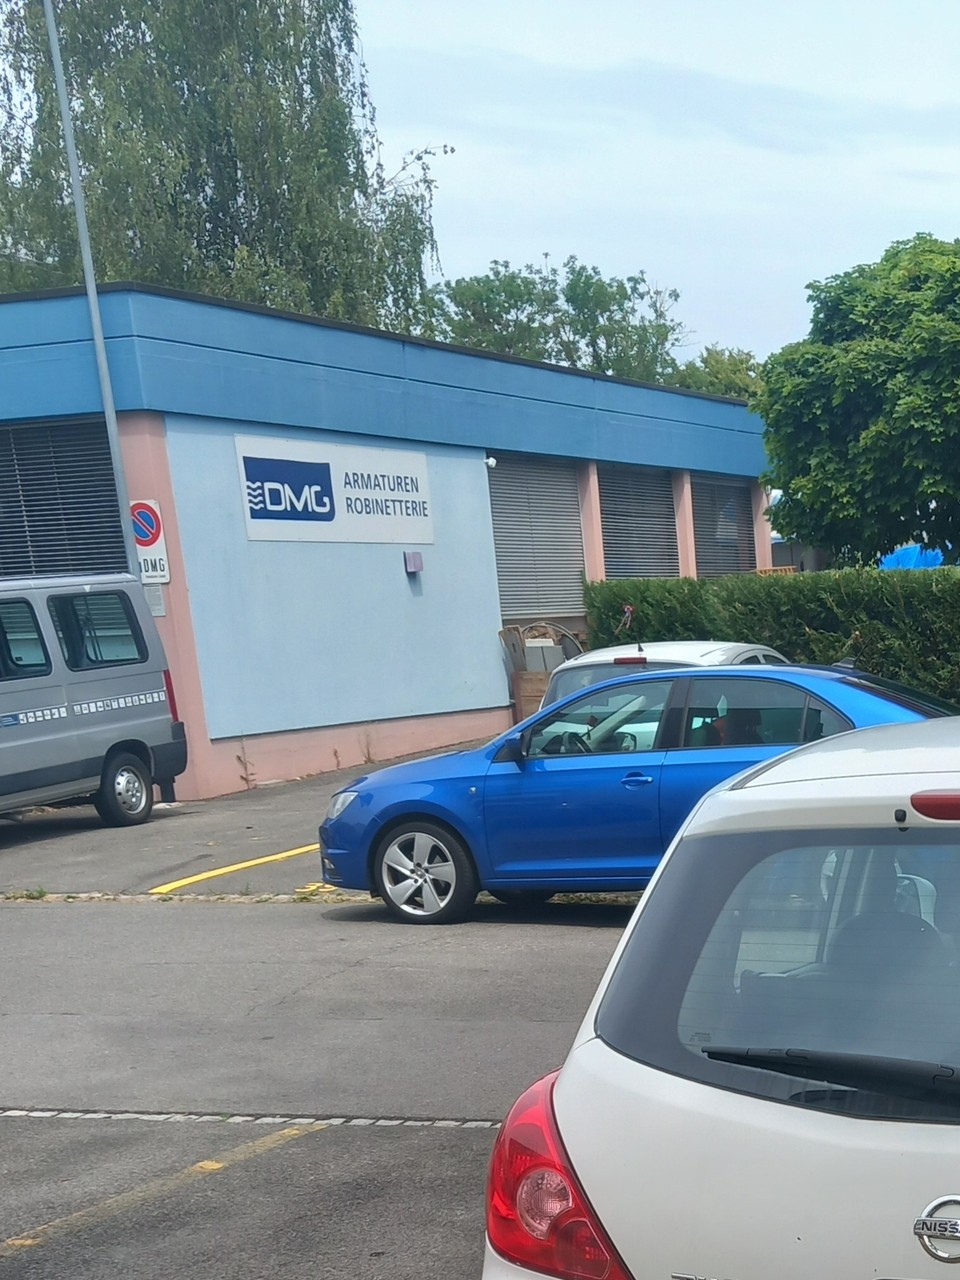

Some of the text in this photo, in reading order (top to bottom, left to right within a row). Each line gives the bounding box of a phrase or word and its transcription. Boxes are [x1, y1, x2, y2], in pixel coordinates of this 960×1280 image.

[344, 472, 419, 493] ARMATUREN
[264, 482, 330, 513] DMG
[346, 497, 429, 517] ROBINETTERIE
[142, 558, 166, 573] DMG
